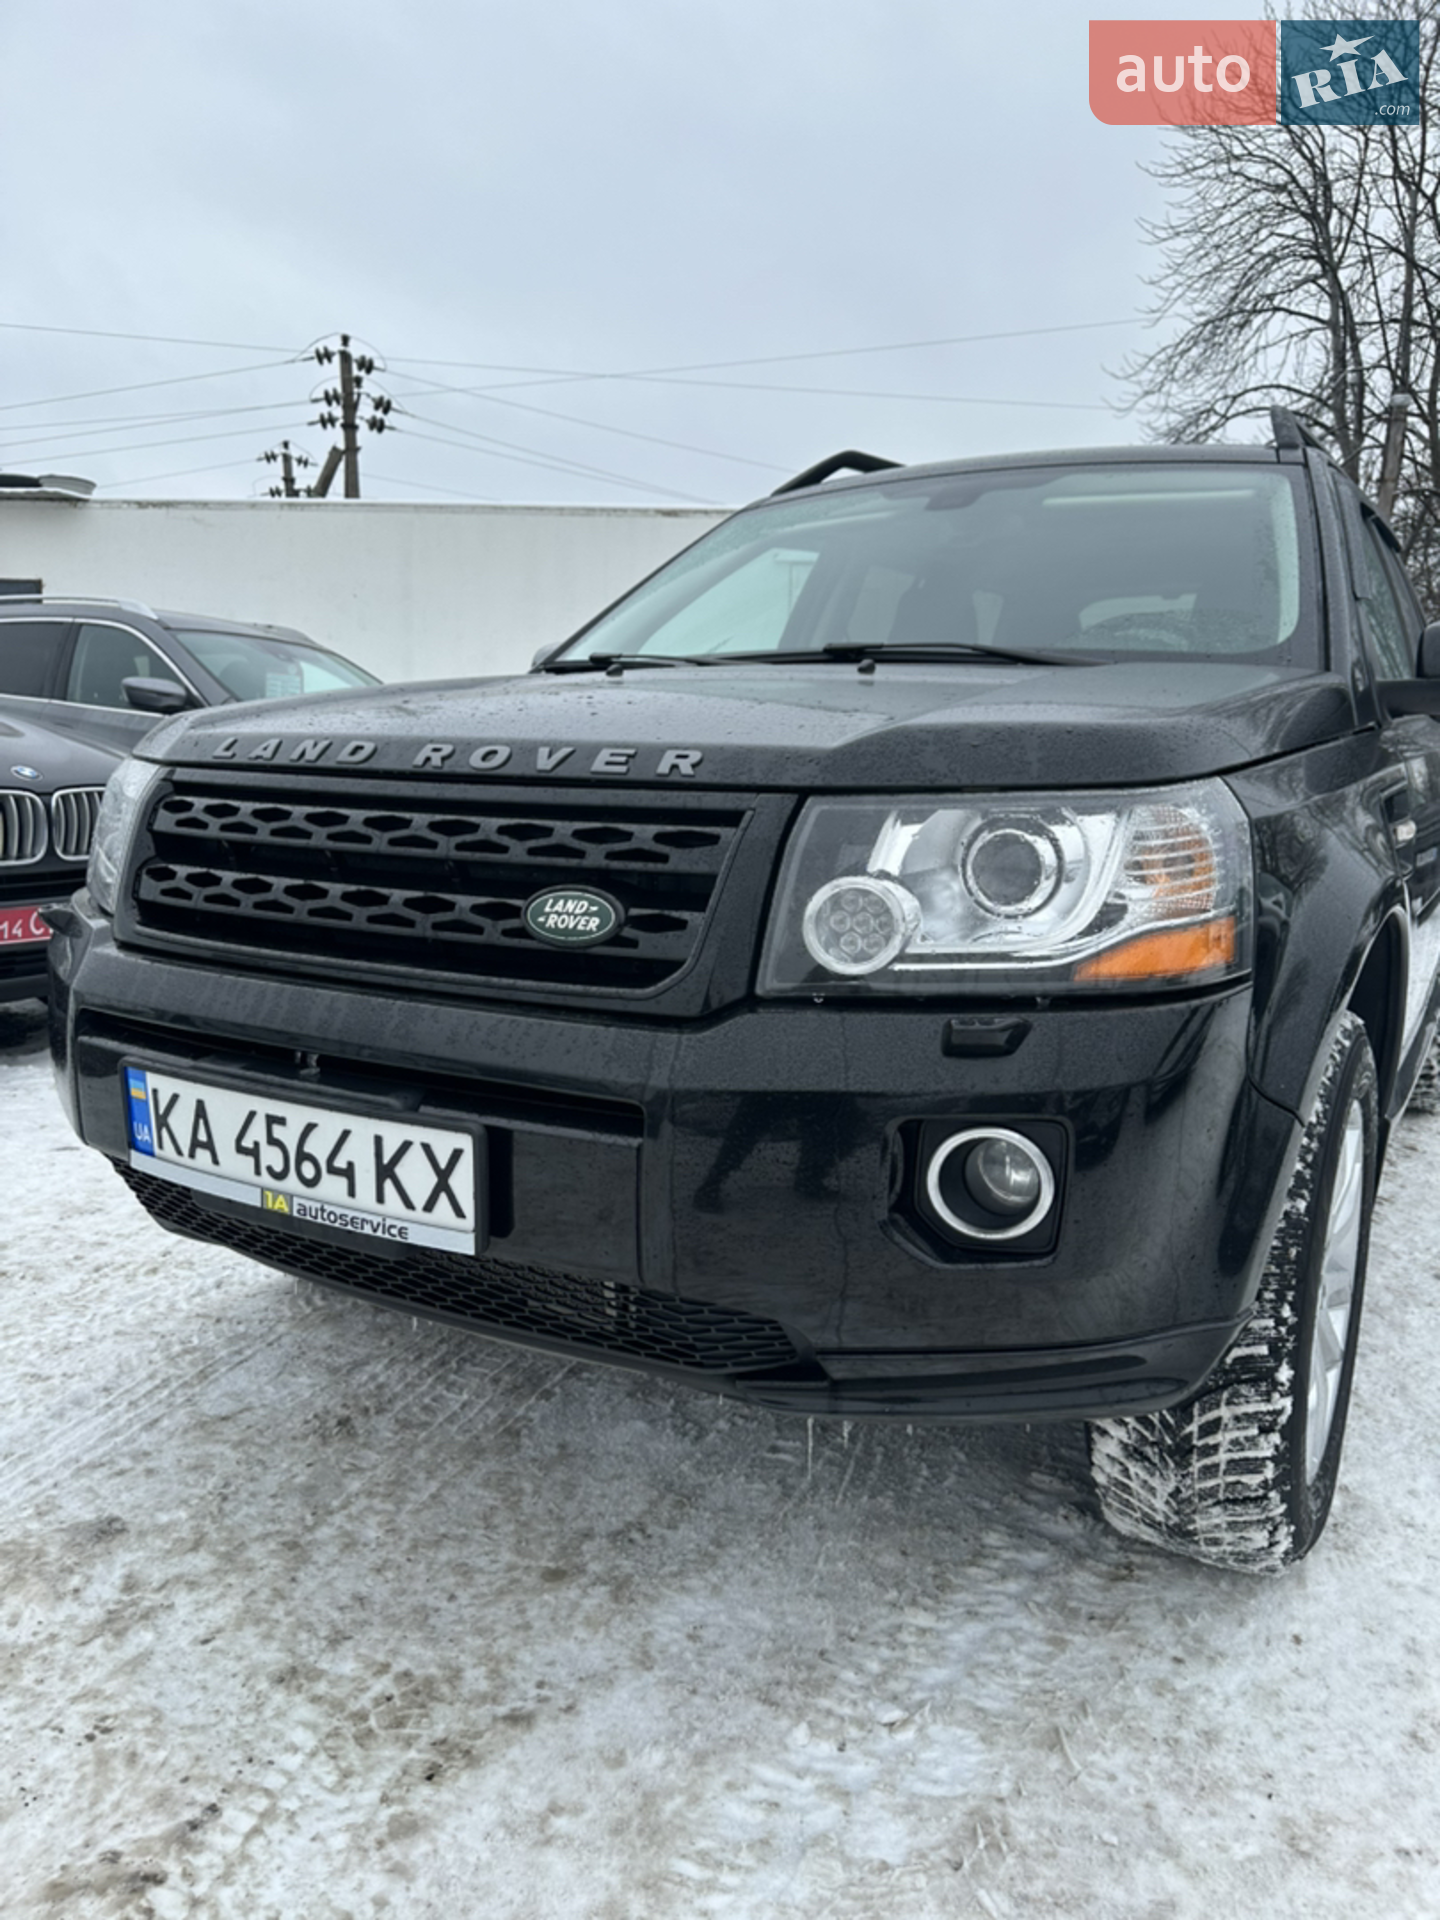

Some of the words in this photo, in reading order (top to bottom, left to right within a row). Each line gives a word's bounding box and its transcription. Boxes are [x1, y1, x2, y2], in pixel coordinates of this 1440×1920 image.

[212, 737, 378, 765] LAND
[412, 743, 704, 777] ROVER
[133, 1122, 151, 1144] UA
[151, 1088, 220, 1166] KA
[235, 1110, 356, 1199] 4564
[373, 1134, 467, 1220] KX
[264, 1190, 289, 1213] 1A
[296, 1201, 409, 1241] autoservice
